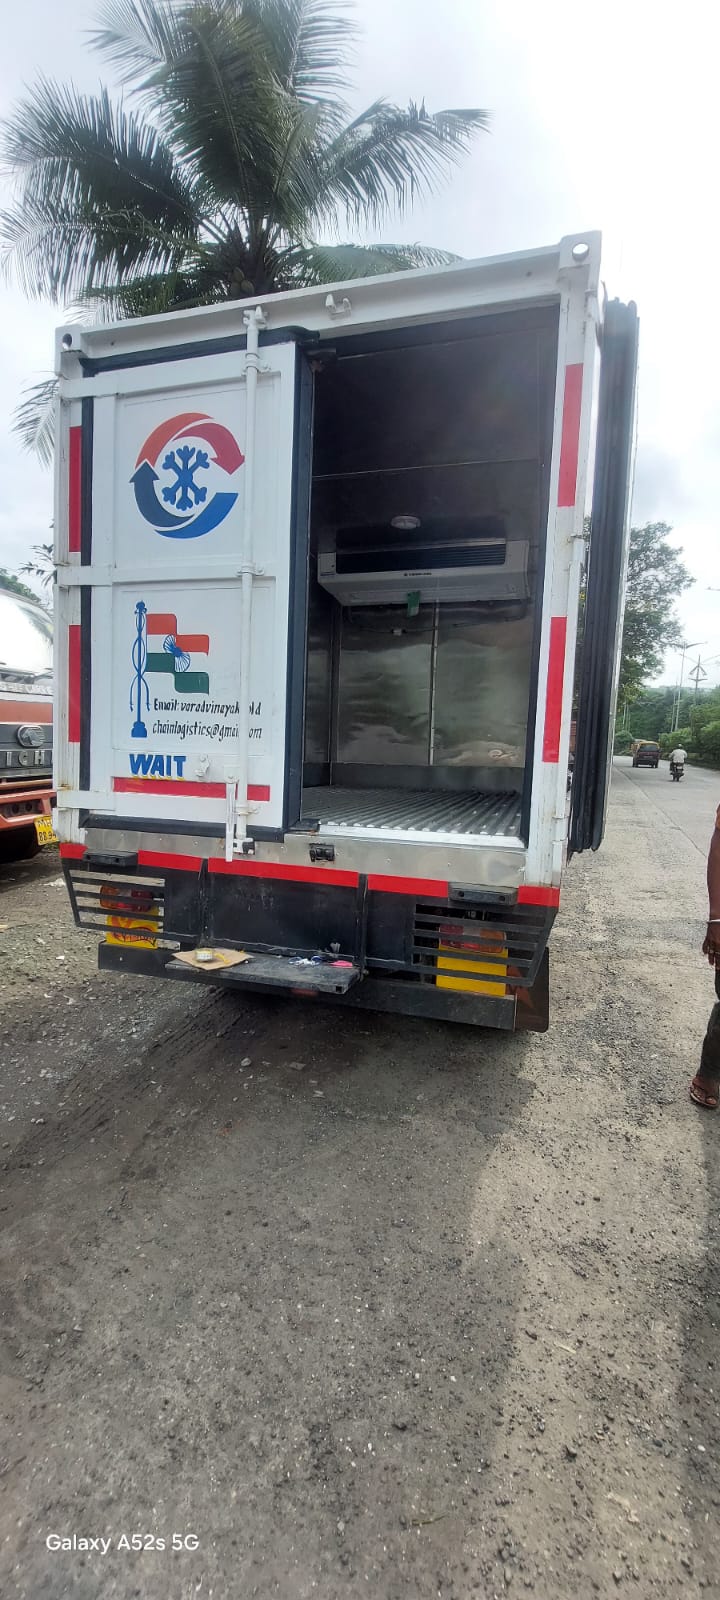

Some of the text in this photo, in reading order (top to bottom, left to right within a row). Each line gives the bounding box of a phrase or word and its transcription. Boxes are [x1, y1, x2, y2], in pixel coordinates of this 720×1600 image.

[152, 720, 263, 741] chainlogistics@gmaiom
[6, 750, 53, 767] ICH
[129, 754, 186, 778] WAIT
